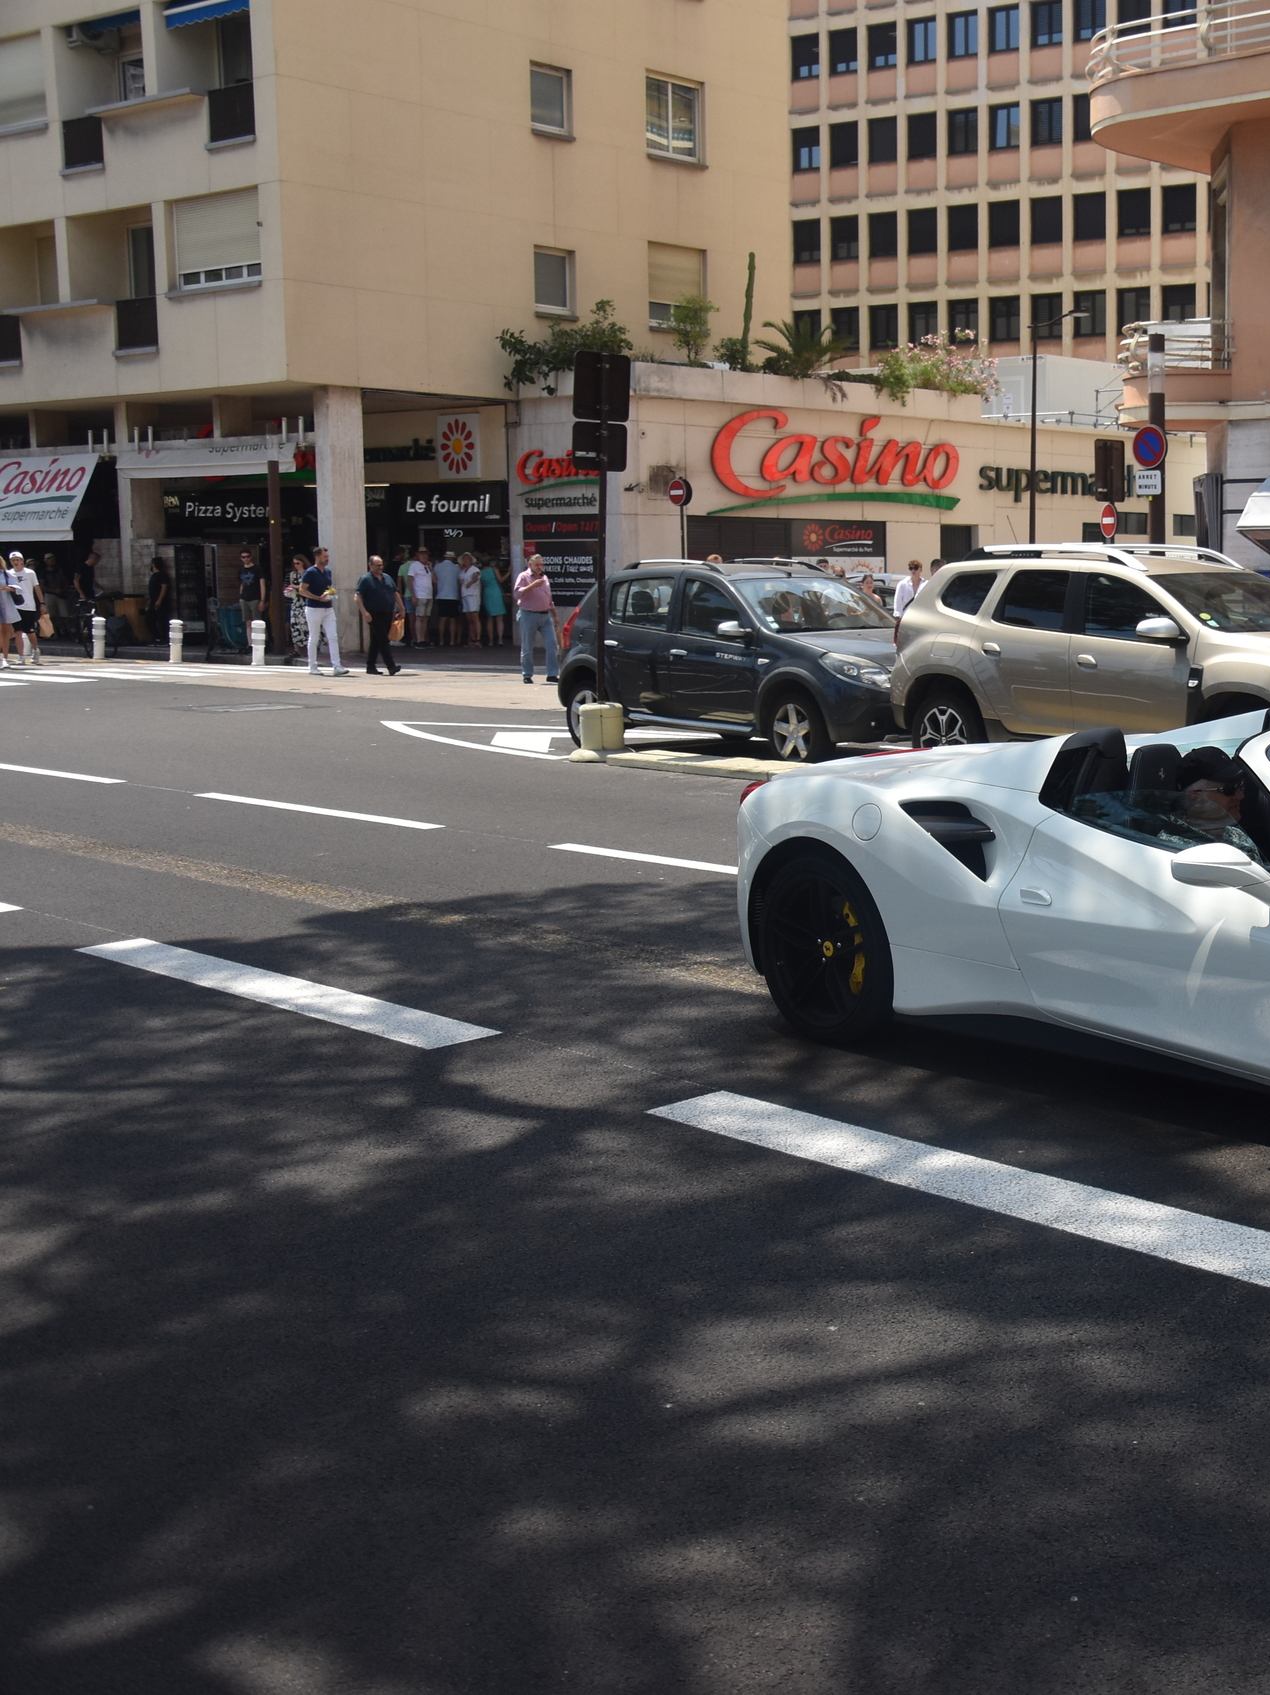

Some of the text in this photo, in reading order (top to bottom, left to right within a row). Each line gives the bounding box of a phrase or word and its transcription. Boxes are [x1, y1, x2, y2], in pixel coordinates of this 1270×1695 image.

[711, 410, 960, 498] Casino
[516, 449, 600, 485] Casi
[185, 502, 221, 517] Pizza
[406, 494, 490, 513] Le fournil
[524, 493, 597, 509] supermarché
[2, 506, 69, 523] supermarché
[525, 522, 551, 532] Ouvert
[556, 522, 578, 532] Open
[825, 525, 873, 543] Casino
[715, 652, 747, 661] STEPWAY
